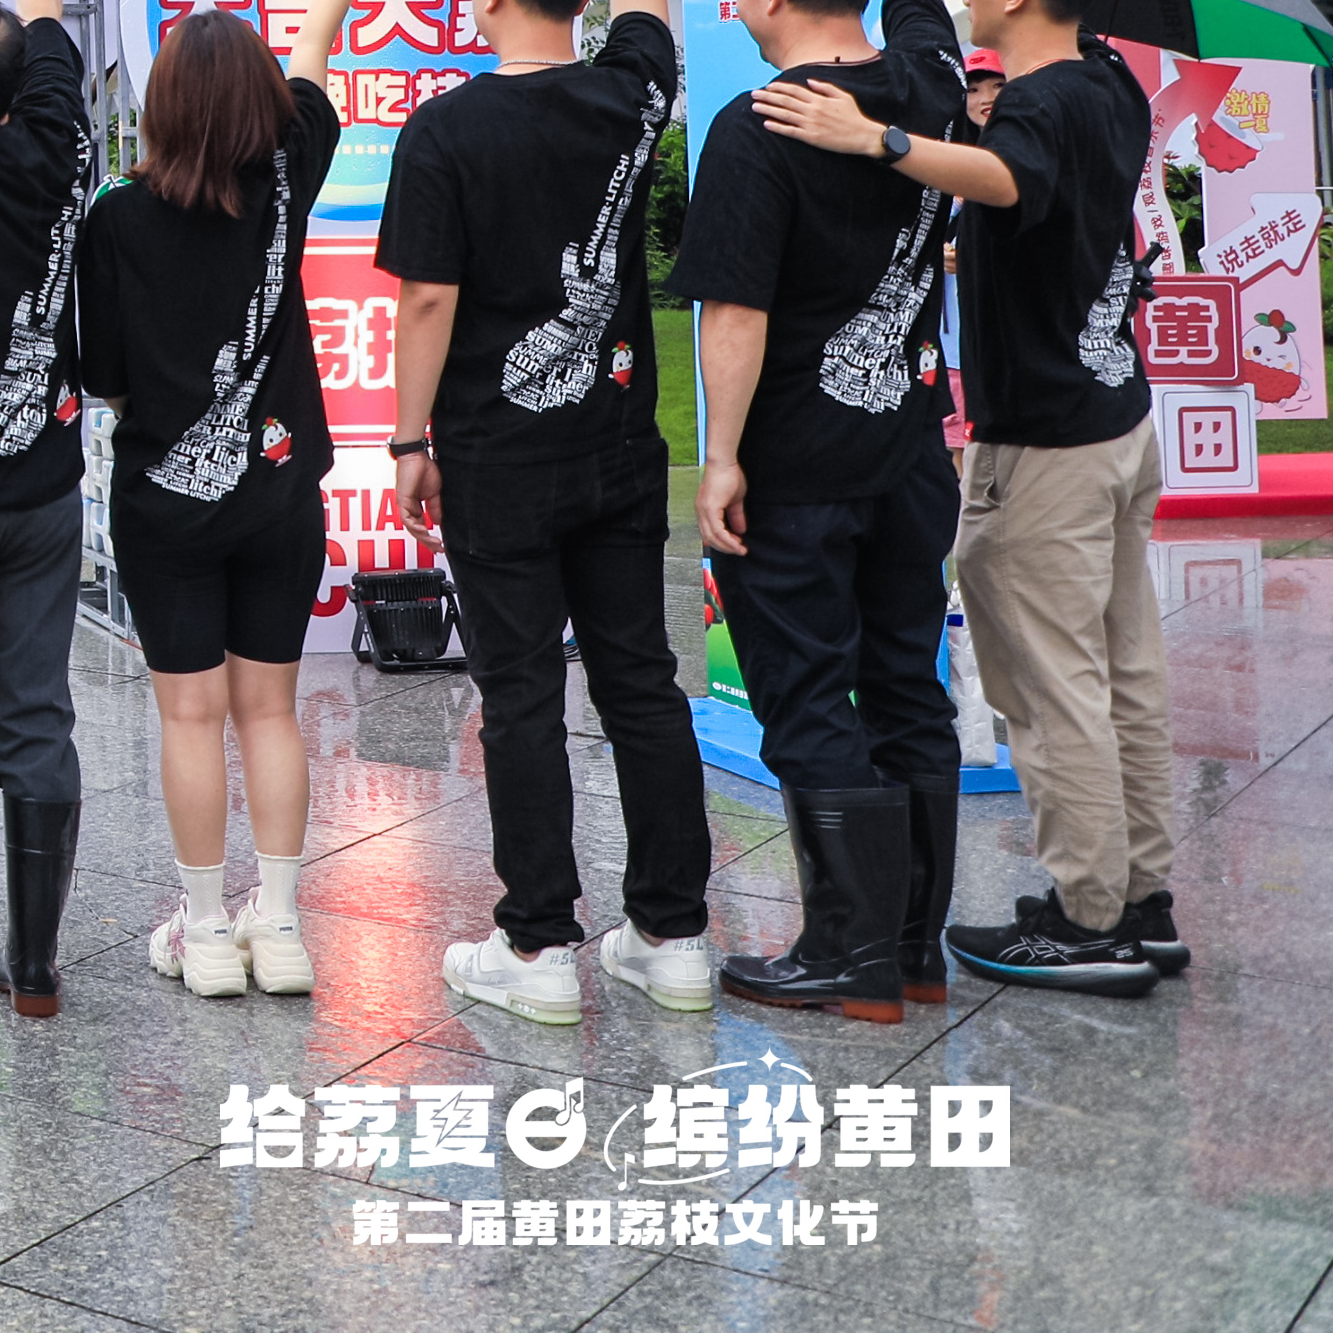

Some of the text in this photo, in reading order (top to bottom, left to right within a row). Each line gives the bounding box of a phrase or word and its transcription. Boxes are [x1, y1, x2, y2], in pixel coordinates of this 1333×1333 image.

[1224, 89, 1271, 117] 激情
[1217, 208, 1307, 275] 说走就走
[1146, 297, 1219, 364] 黄
